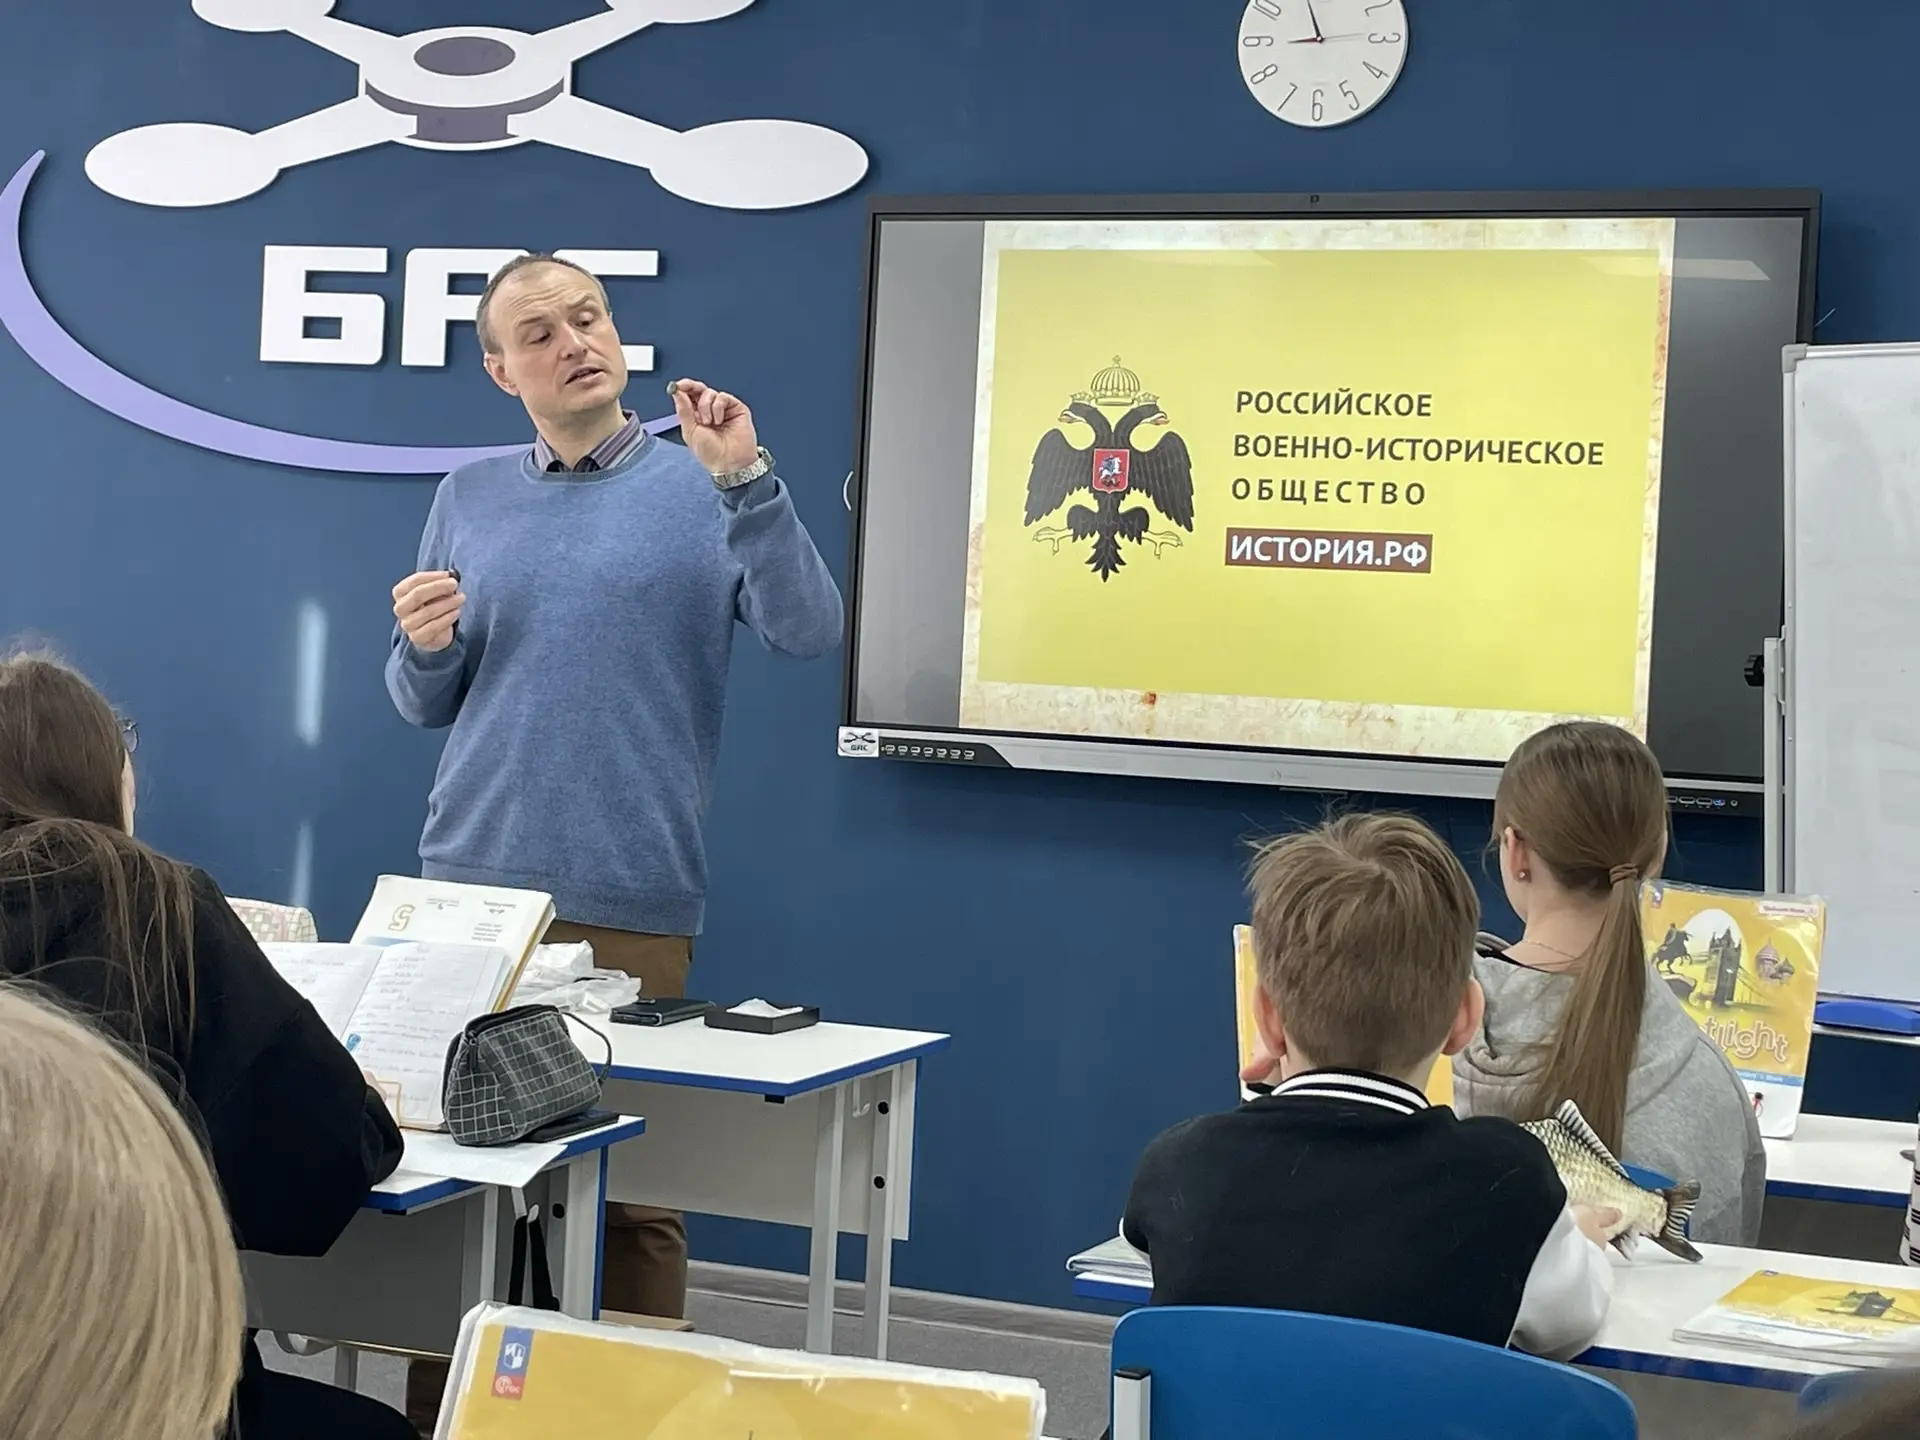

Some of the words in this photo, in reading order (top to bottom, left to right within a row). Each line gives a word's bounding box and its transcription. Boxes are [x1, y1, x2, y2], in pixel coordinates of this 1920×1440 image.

[1242, 35, 1274, 47] 9
[1367, 32, 1401, 44] 3
[1250, 63, 1278, 85] 8
[1362, 60, 1390, 80] 4
[1277, 82, 1298, 112] 7
[1311, 89, 1324, 122] 6
[1338, 79, 1360, 111] 5
[1236, 388, 1432, 417] РОССИЙСКОЕ
[1234, 434, 1604, 465] ВОЕННО-ИСТОРИЧЕСКОЕ
[1231, 478, 1425, 505] ОБЩЕСТВО
[1231, 535, 1427, 567] ИСТОРИЯ.РФ
[1702, 1016, 1788, 1063] tlight
